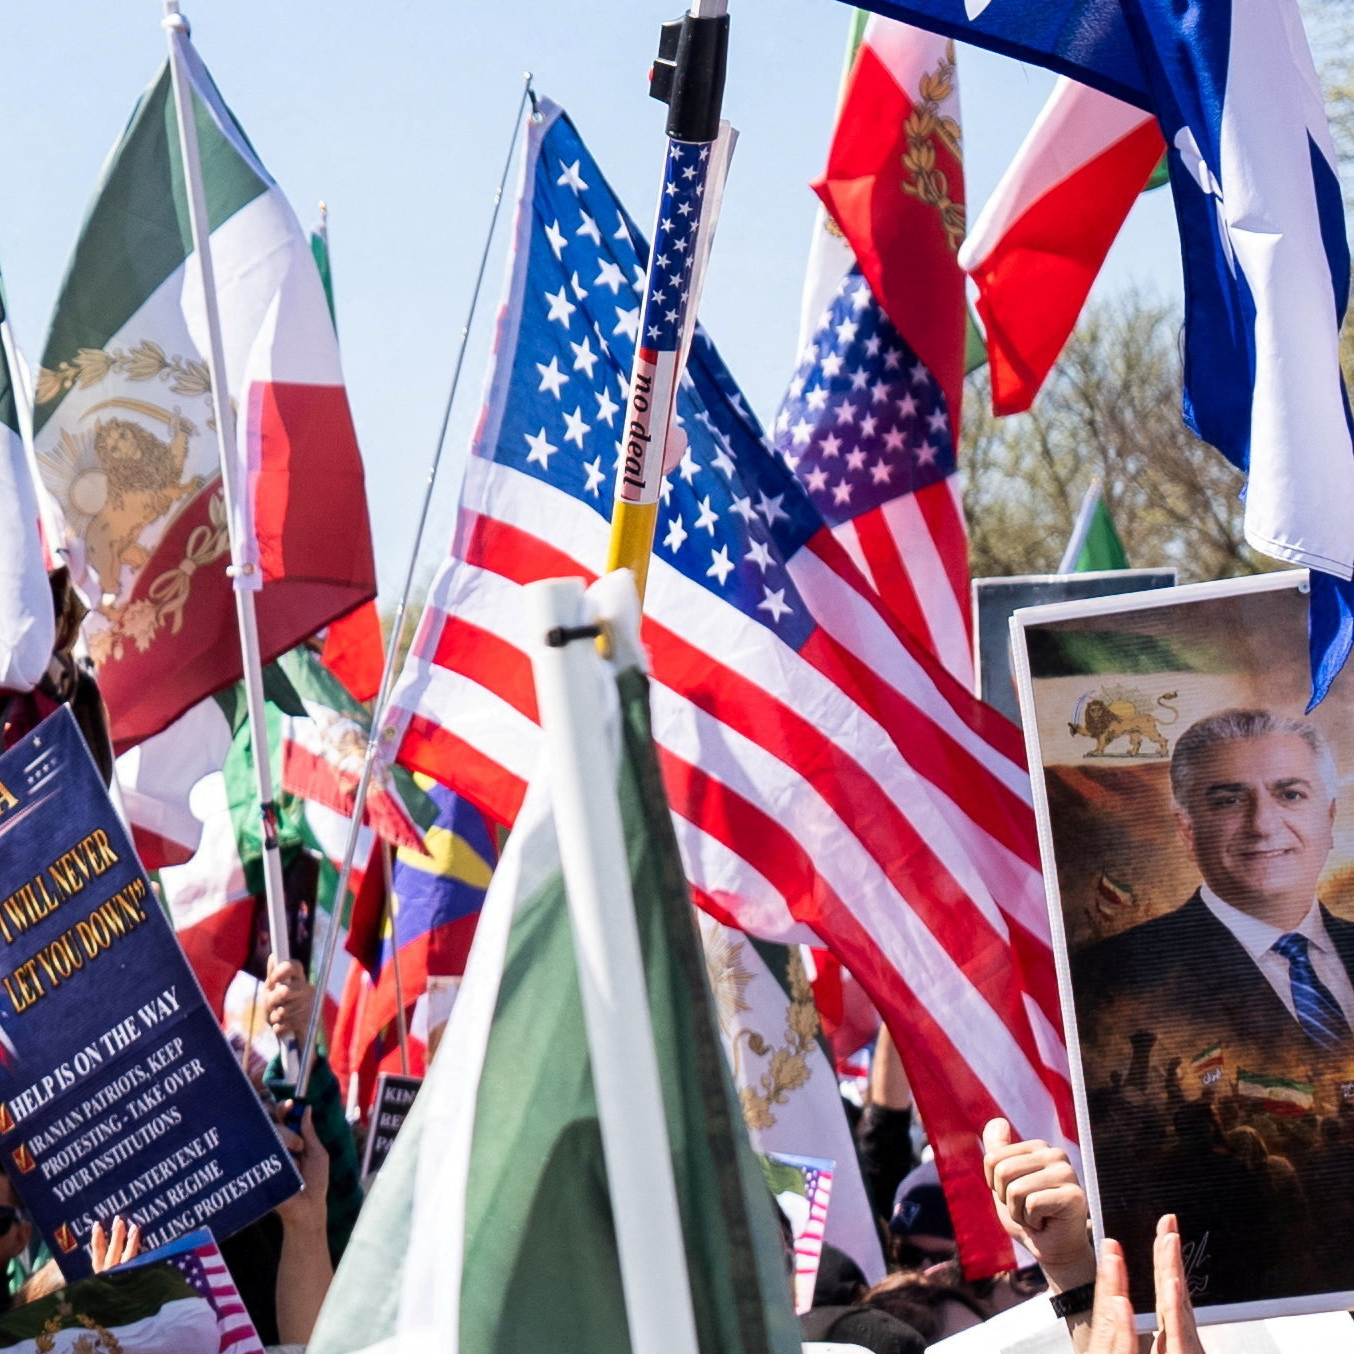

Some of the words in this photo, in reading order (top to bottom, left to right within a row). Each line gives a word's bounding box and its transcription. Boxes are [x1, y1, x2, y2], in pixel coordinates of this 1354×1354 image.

[633, 373, 652, 413] no
[623, 421, 652, 489] deal
[1, 877, 61, 932] WILL
[45, 830, 119, 901] NEVER
[2, 962, 46, 1013] LET
[35, 932, 85, 986] YOU
[8, 1077, 55, 1122] HELP
[54, 1065, 76, 1091] IS
[71, 1045, 104, 1078] ON
[99, 1018, 142, 1058] THE
[136, 988, 181, 1029] WAY
[27, 1110, 85, 1156] IRANIAN
[81, 1067, 151, 1119] PATRIOTS,
[146, 1039, 185, 1075] KEEP
[384, 1086, 415, 1104] KIN
[40, 1116, 123, 1180] PROTESTING
[126, 1086, 166, 1120] TAKE
[161, 1060, 206, 1096] OVER
[52, 1169, 93, 1202] YOUR
[88, 1108, 183, 1178] INSTITUTIONS
[93, 1189, 132, 1221] WILL
[128, 1139, 206, 1199] INTERVENE
[201, 1129, 221, 1150] IF
[142, 1210, 196, 1250] ILLING
[192, 1156, 283, 1222] PROTESTERS
[165, 1162, 224, 1207] REGIME
